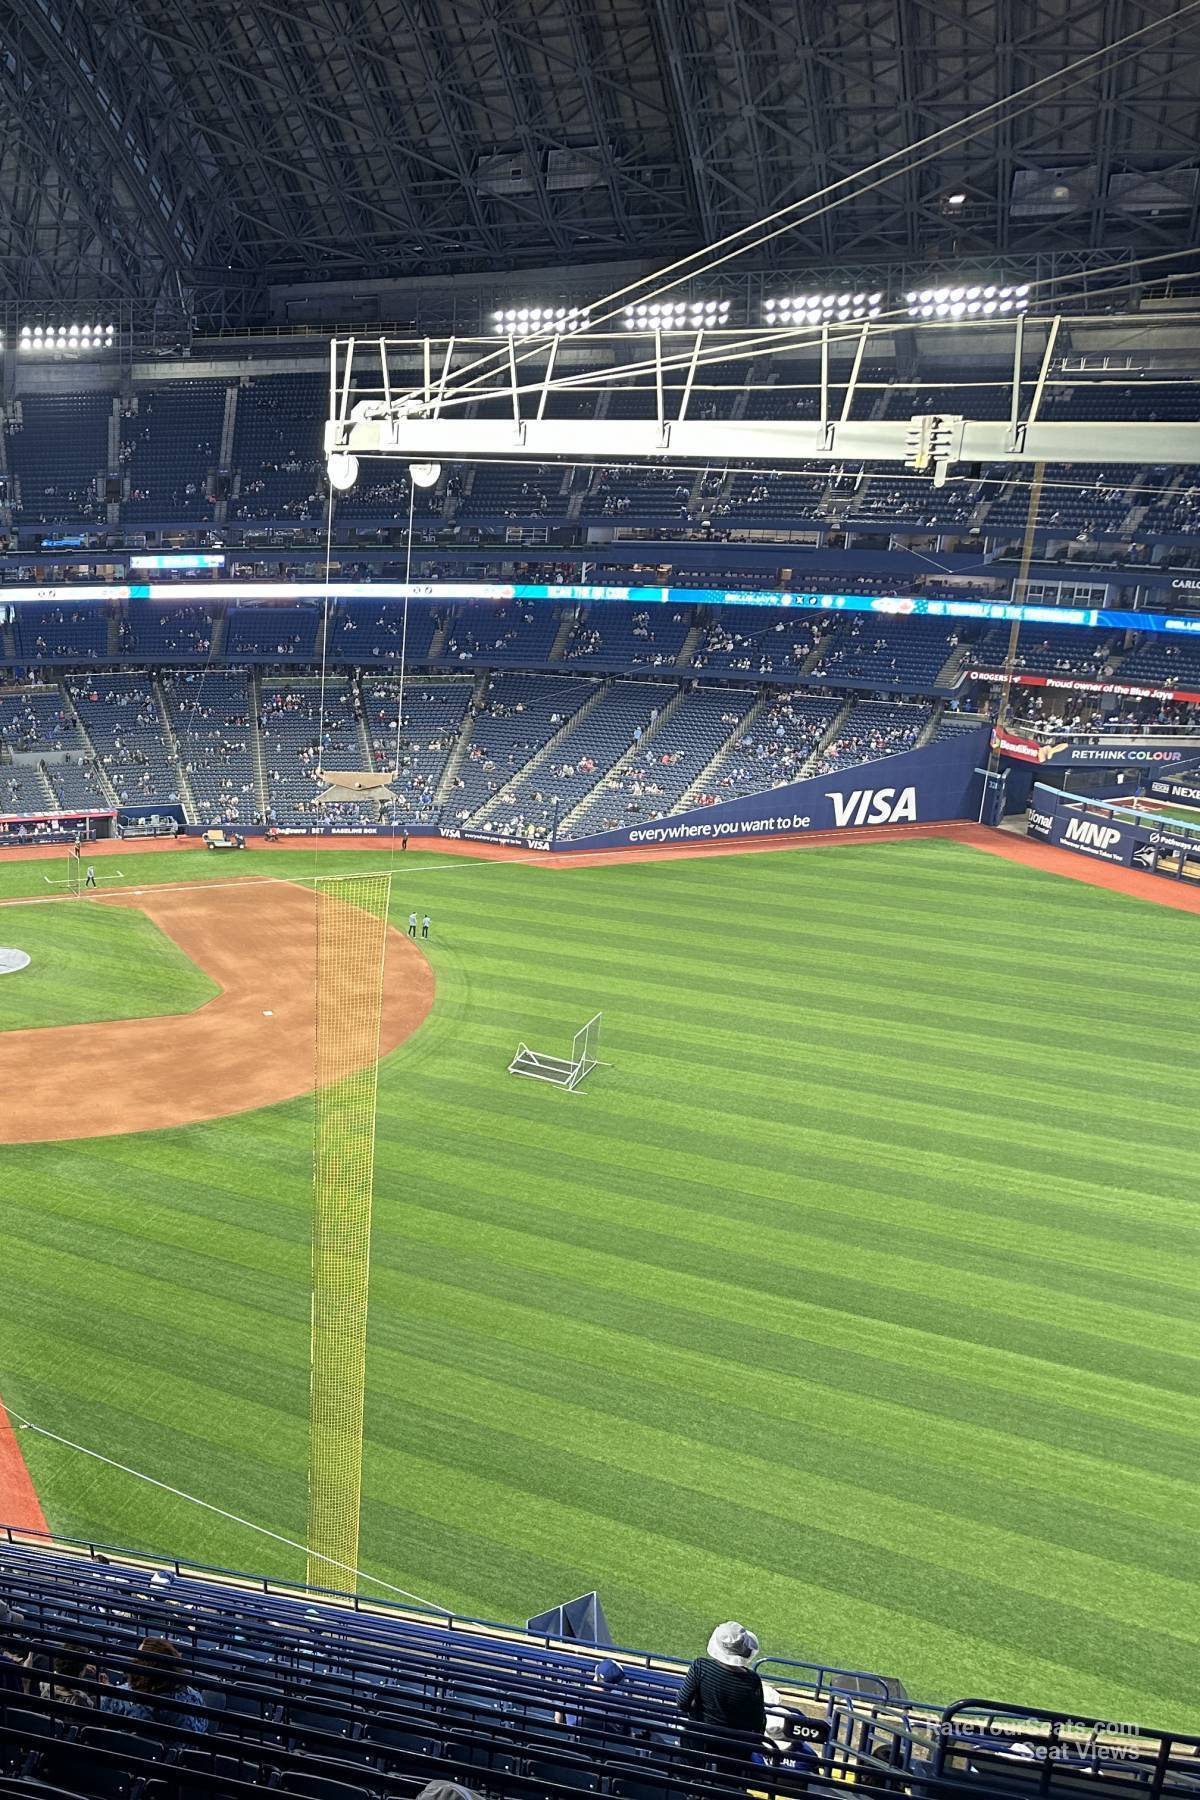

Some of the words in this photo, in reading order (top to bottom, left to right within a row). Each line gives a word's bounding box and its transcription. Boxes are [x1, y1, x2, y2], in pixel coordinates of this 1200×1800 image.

[979, 673, 1008, 682] ROGERS
[1046, 678, 1074, 689] Proud
[1074, 682, 1102, 692] owner
[1102, 684, 1113, 692] of
[1113, 685, 1130, 694] the
[1130, 687, 1151, 697] Blue
[1151, 690, 1174, 701] Jays
[1071, 750, 1126, 760] RETHINK
[1127, 750, 1182, 761] COLOUR
[825, 787, 917, 827] VISA
[439, 827, 461, 839] VISA
[629, 822, 711, 841] everywhere
[710, 823, 738, 838] you
[741, 818, 774, 834] want
[776, 817, 791, 829] to
[792, 814, 810, 829] be
[1065, 817, 1121, 850] MNP
[464, 833, 490, 841] everywhere
[1160, 836, 1192, 850] Pathways
[527, 839, 550, 851] VISA
[792, 1725, 820, 1738] 509
